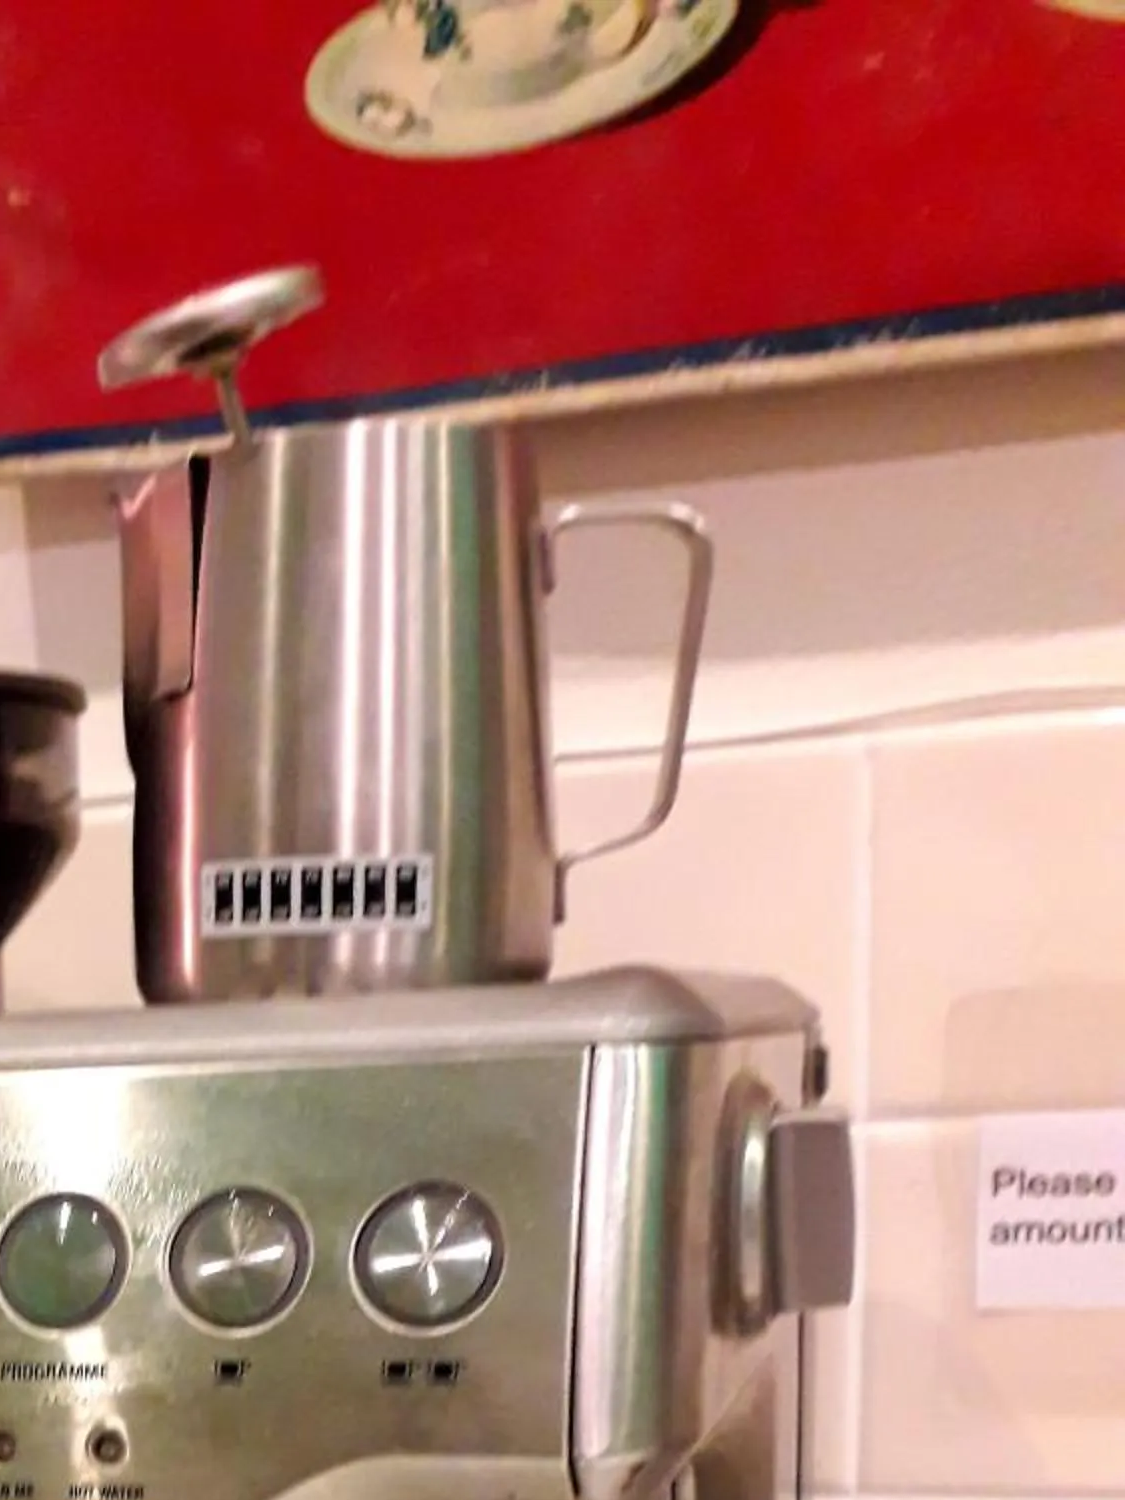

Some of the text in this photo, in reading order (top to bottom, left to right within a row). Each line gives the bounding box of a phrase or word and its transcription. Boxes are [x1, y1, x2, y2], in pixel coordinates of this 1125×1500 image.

[991, 1166, 1116, 1199] Please
[989, 1213, 1125, 1246] amount
[0, 1359, 108, 1382] PROGRAMME
[13, 1481, 35, 1498] ME
[68, 1483, 145, 1500] HOT WATER
